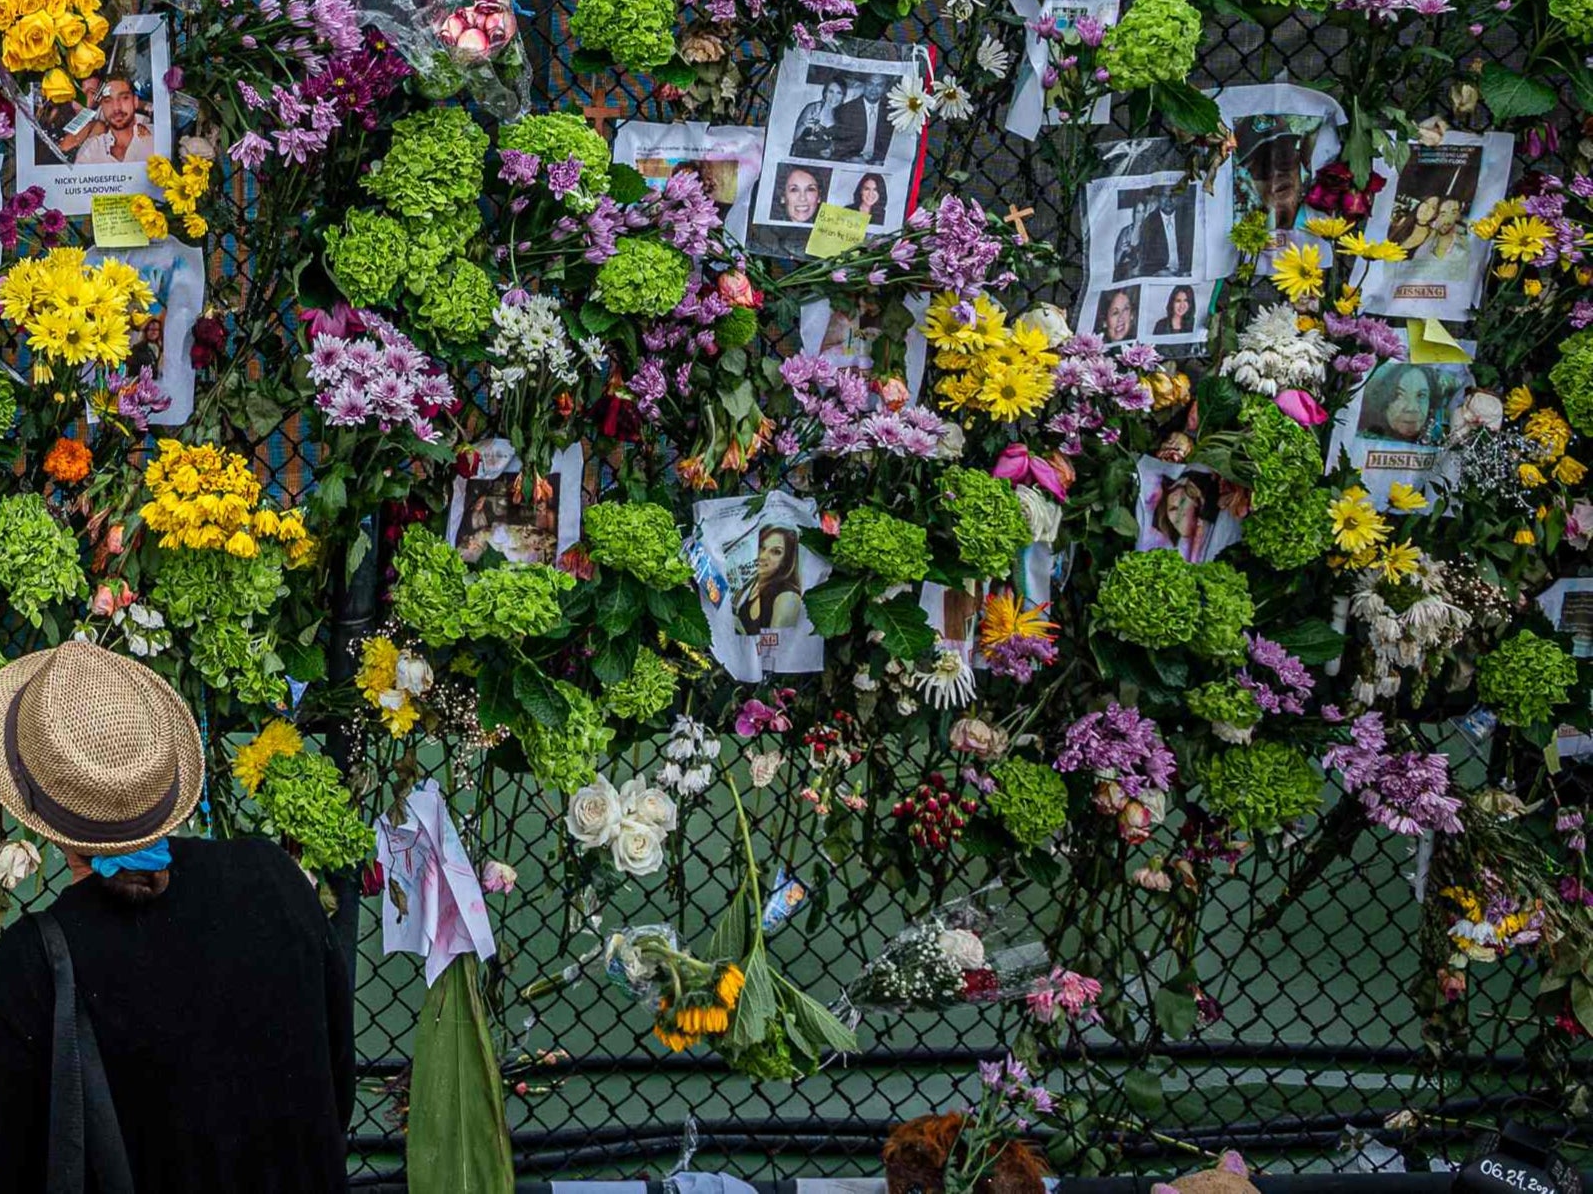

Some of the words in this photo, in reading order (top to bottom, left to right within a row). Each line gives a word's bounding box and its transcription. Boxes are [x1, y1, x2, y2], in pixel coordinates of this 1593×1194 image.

[55, 177, 77, 185] NICKY
[79, 175, 126, 184] LANGESFELD
[65, 187, 81, 195] LUIS
[83, 185, 123, 194] SADOVNIC
[1370, 453, 1432, 468] MISSING
